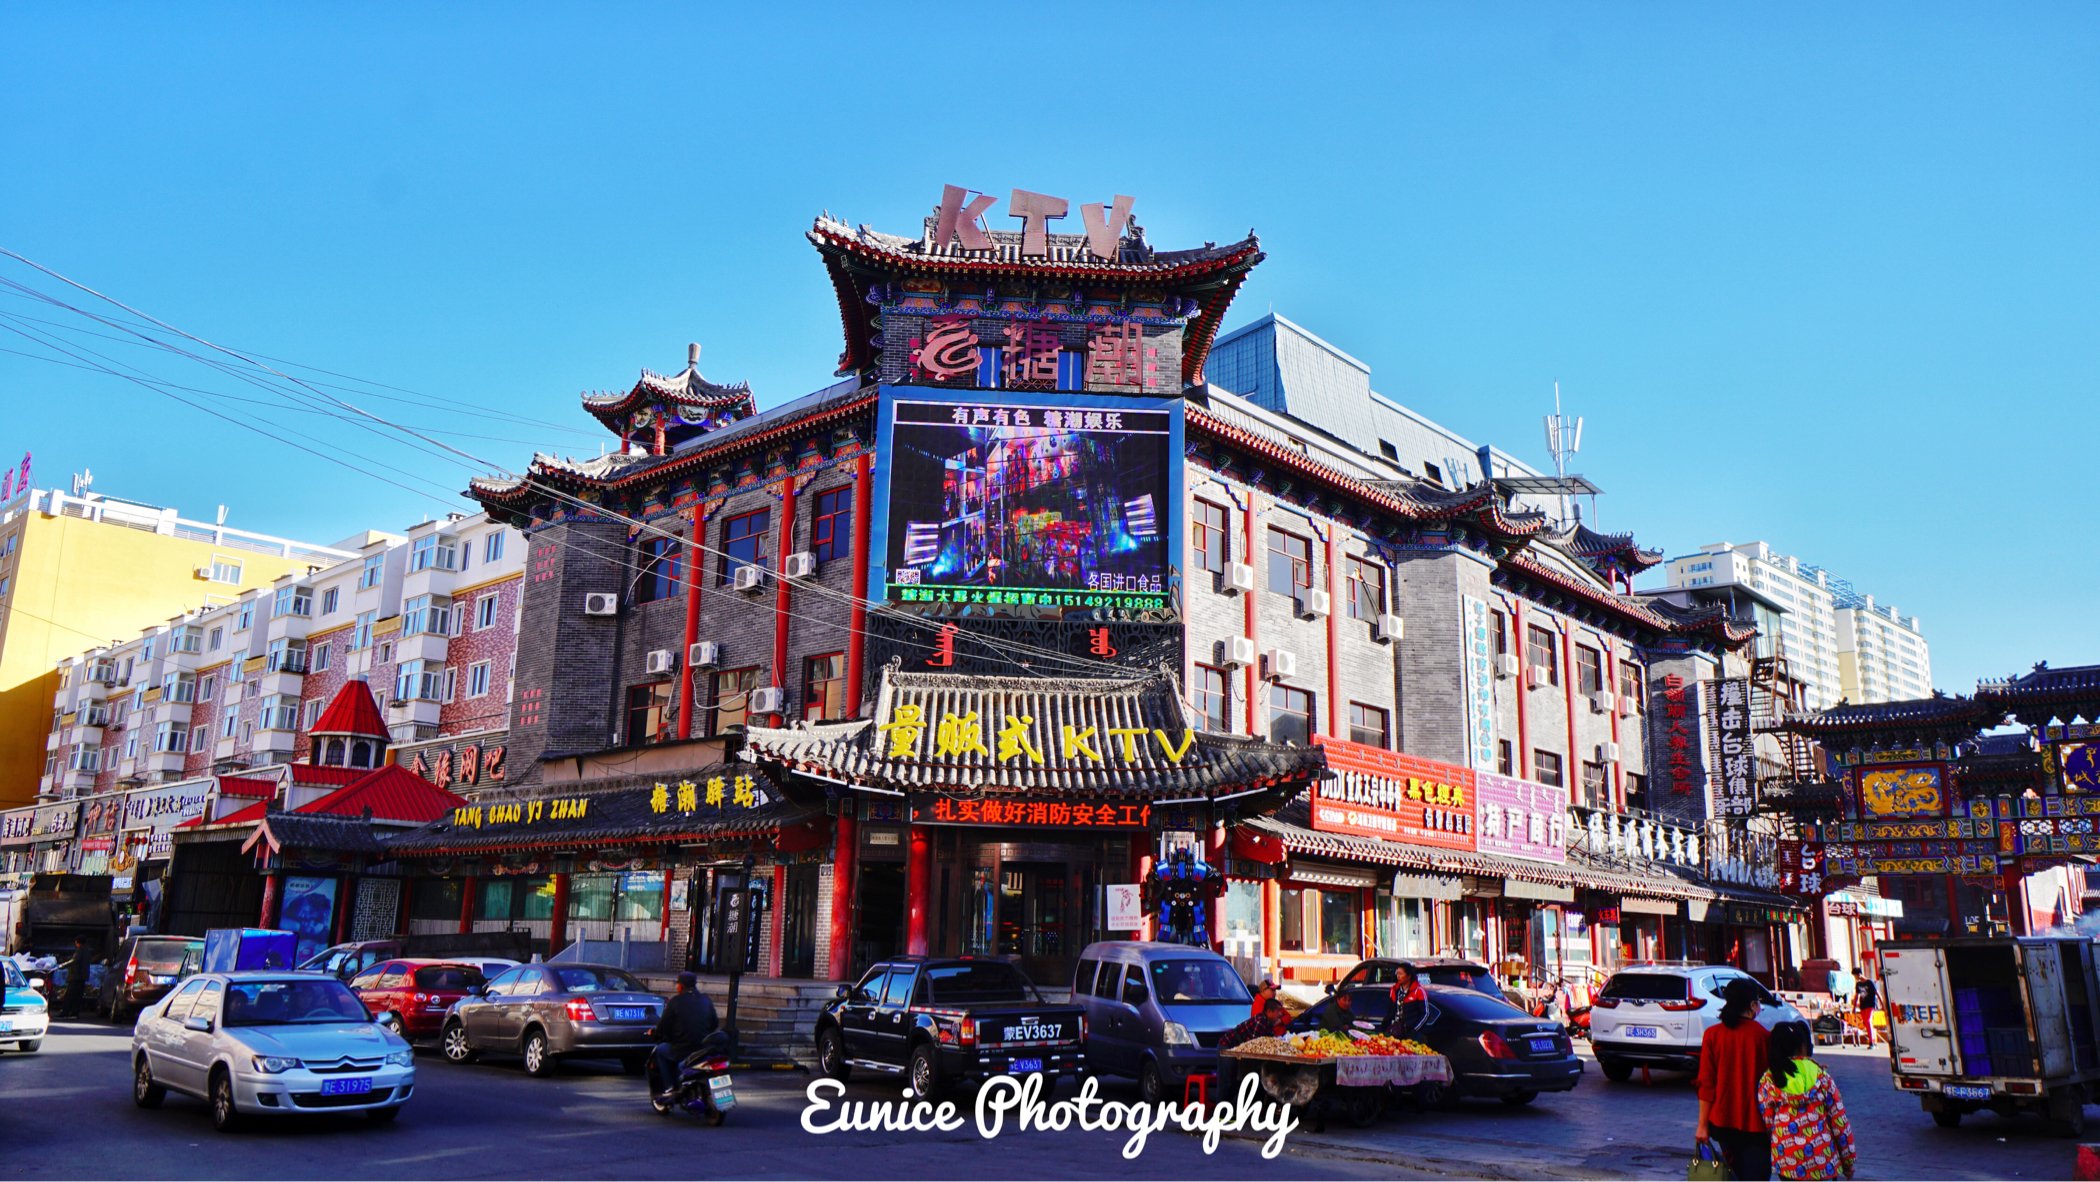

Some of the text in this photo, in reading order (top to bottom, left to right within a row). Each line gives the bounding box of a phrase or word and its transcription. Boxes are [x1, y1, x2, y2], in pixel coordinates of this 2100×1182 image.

[935, 183, 1137, 260] KTV
[1001, 314, 1143, 387] 糖潮
[952, 407, 1123, 430] 有声有色 糖潮娱乐
[1087, 572, 1162, 593] 各国进口食品
[880, 704, 1196, 765] 量贩式 KTV
[454, 807, 482, 829] TANG
[489, 803, 521, 825] CHAO
[550, 798, 589, 819] ZHAN
[1800, 843, 1823, 895] 台球
[1828, 902, 1857, 916] 台球
[1004, 1024, 1062, 1041] 蒙EV3637
